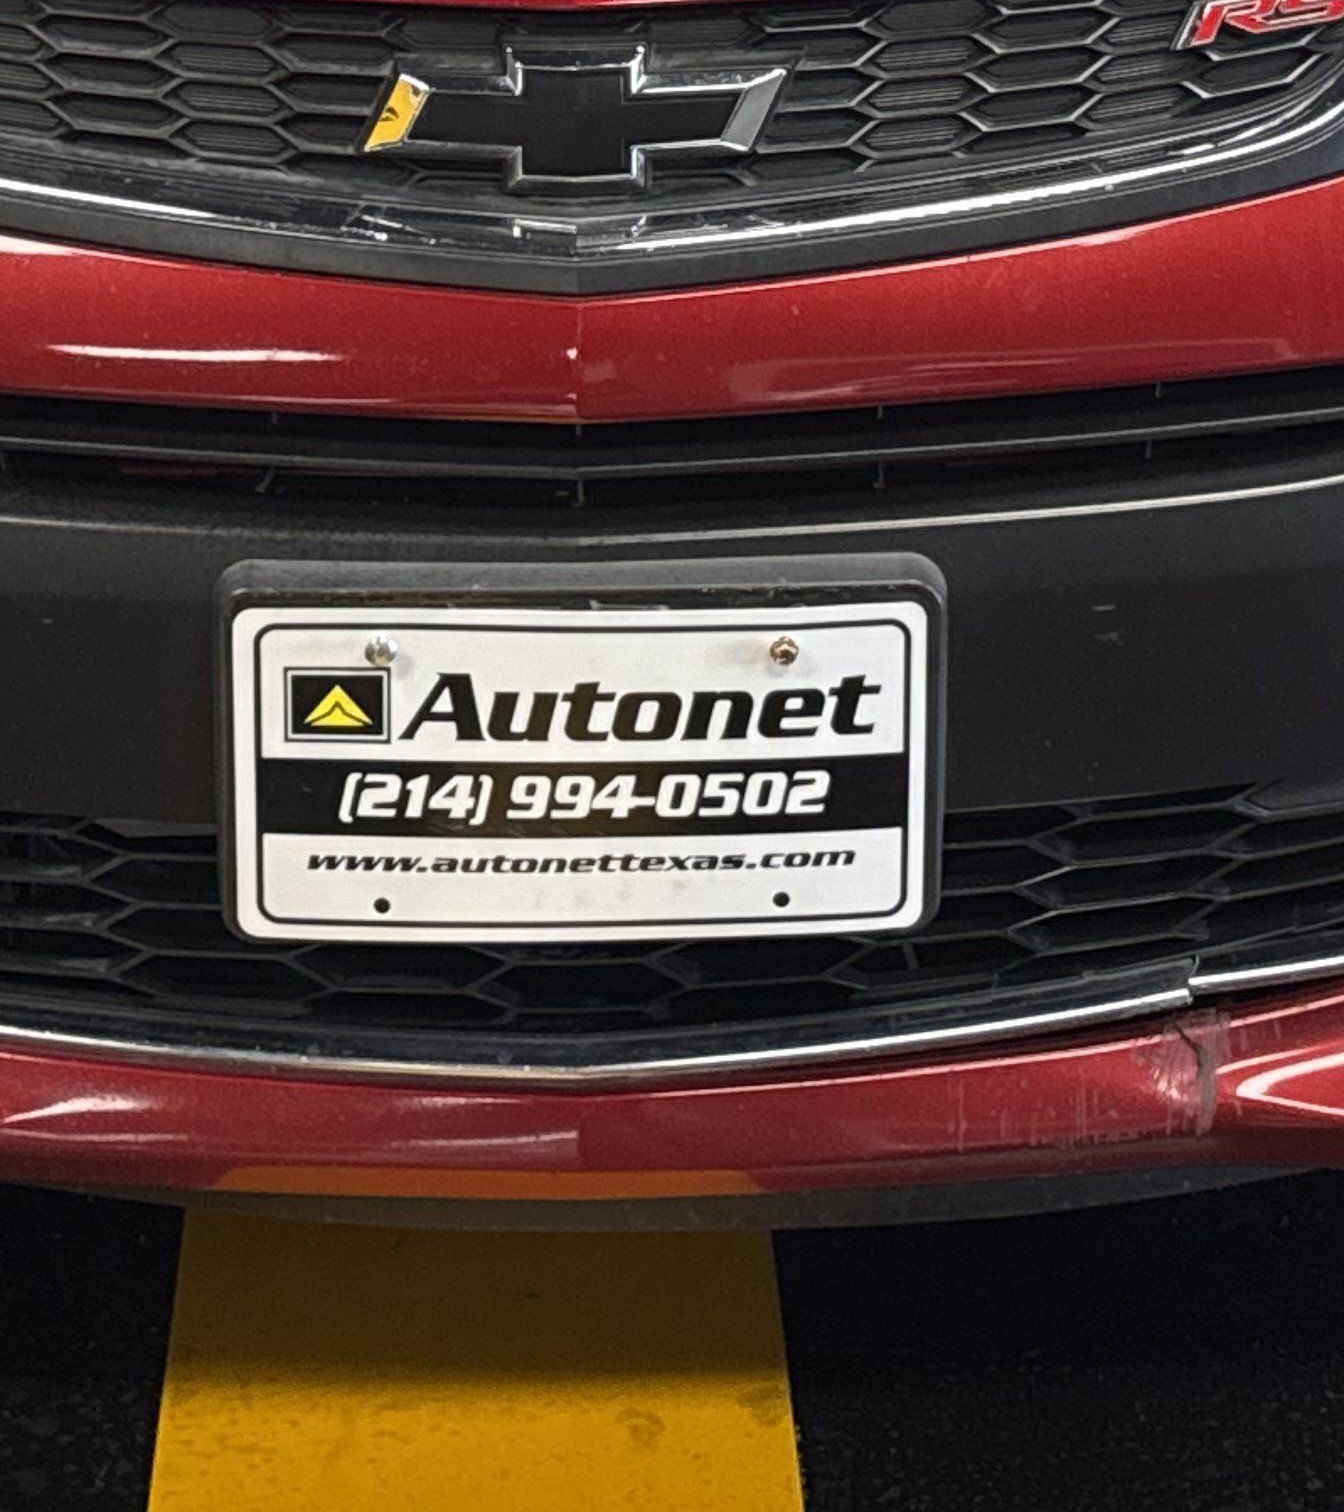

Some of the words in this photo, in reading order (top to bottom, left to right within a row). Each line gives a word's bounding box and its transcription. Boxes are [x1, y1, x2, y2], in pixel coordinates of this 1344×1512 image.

[399, 672, 882, 742] Autonet
[339, 773, 493, 825] (214)
[507, 771, 830, 819] 994-0502
[307, 849, 856, 874] www.autonettexas.com
